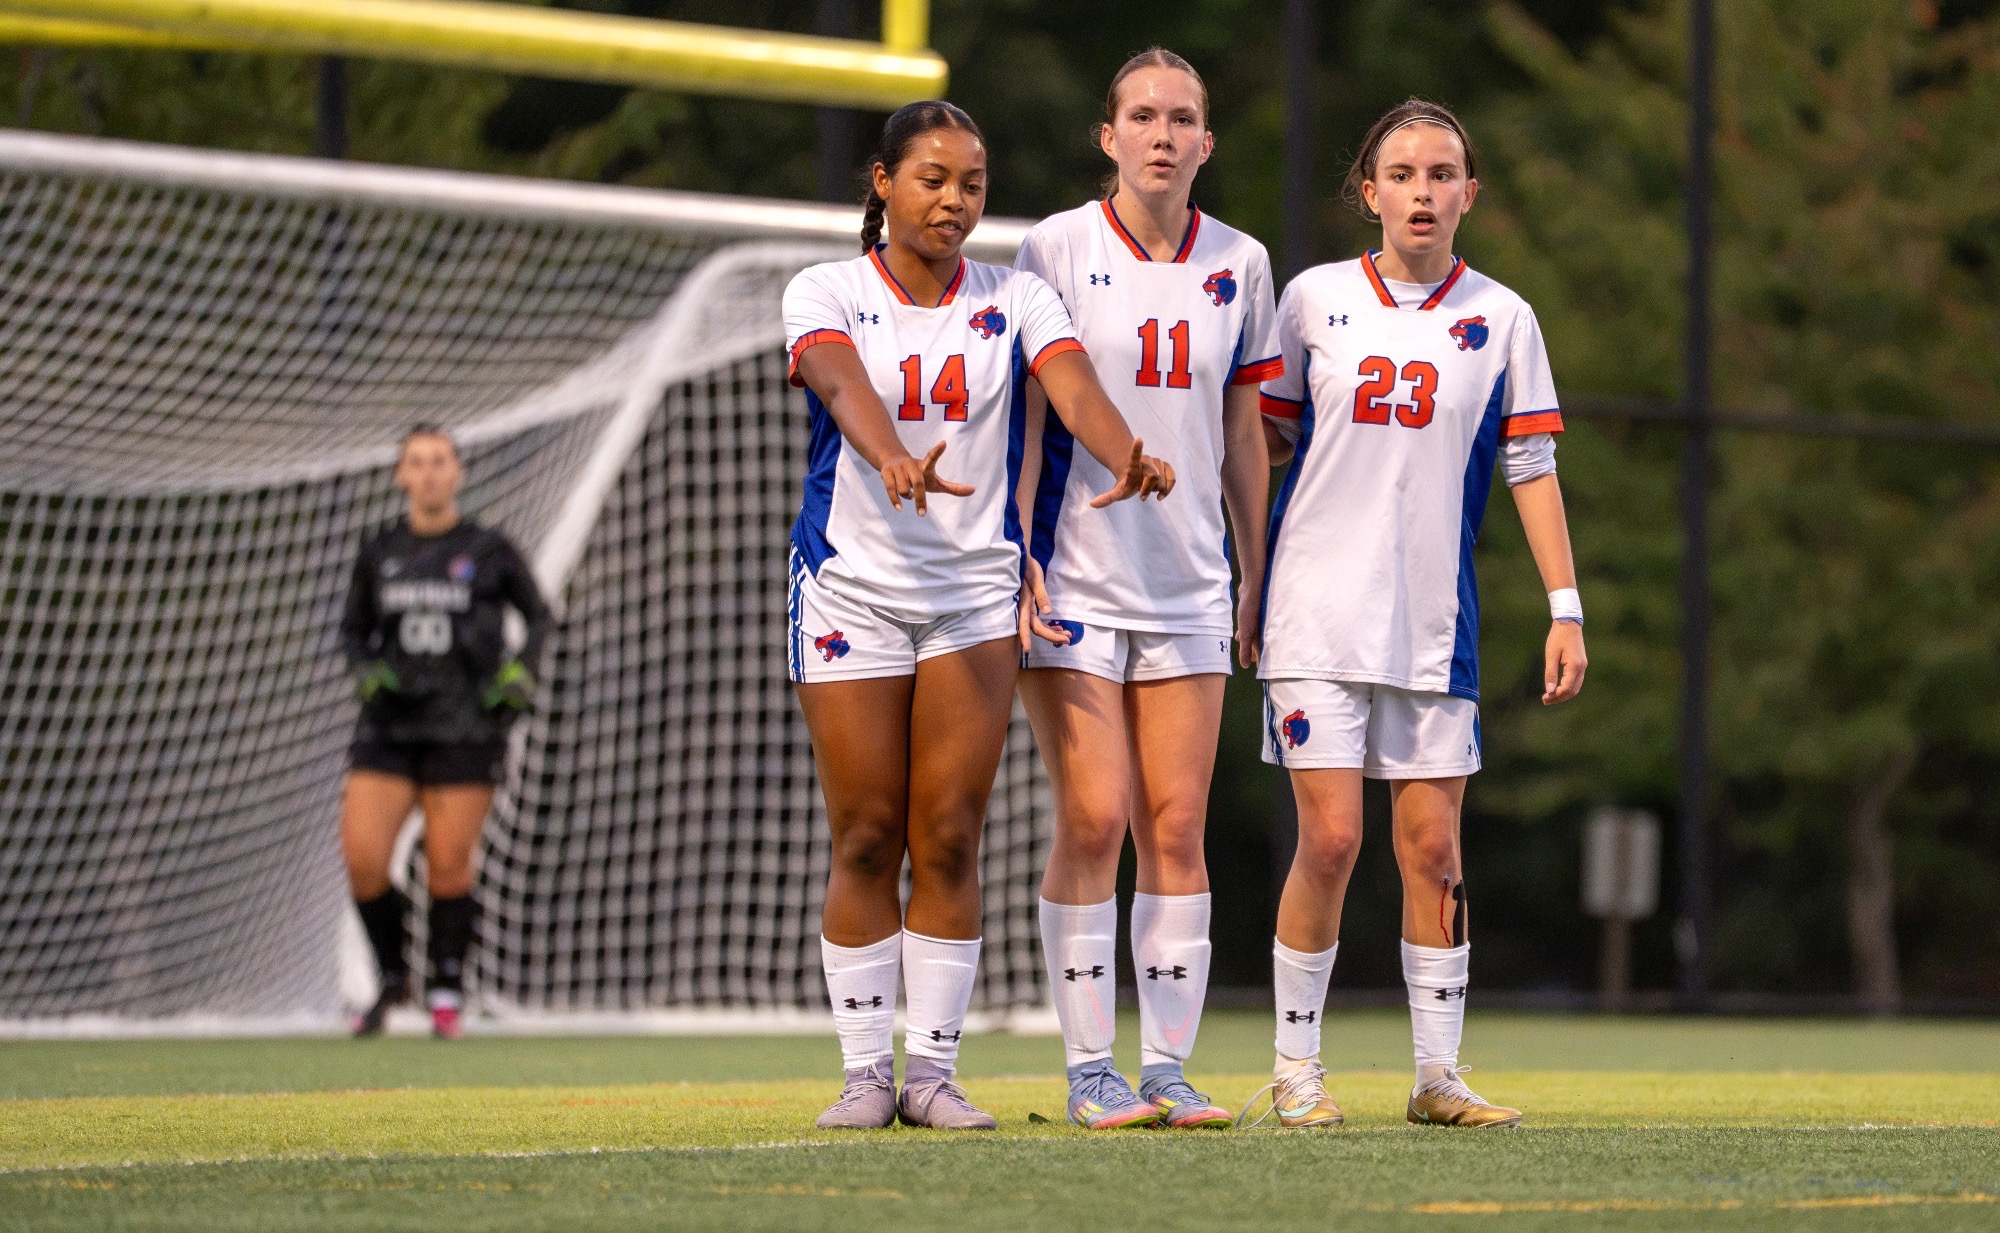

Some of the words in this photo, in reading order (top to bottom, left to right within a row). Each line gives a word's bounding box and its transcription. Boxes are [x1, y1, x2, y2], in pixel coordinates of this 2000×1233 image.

[898, 353, 969, 422] 14
[1135, 318, 1192, 389] 11
[1352, 355, 1439, 429] 23
